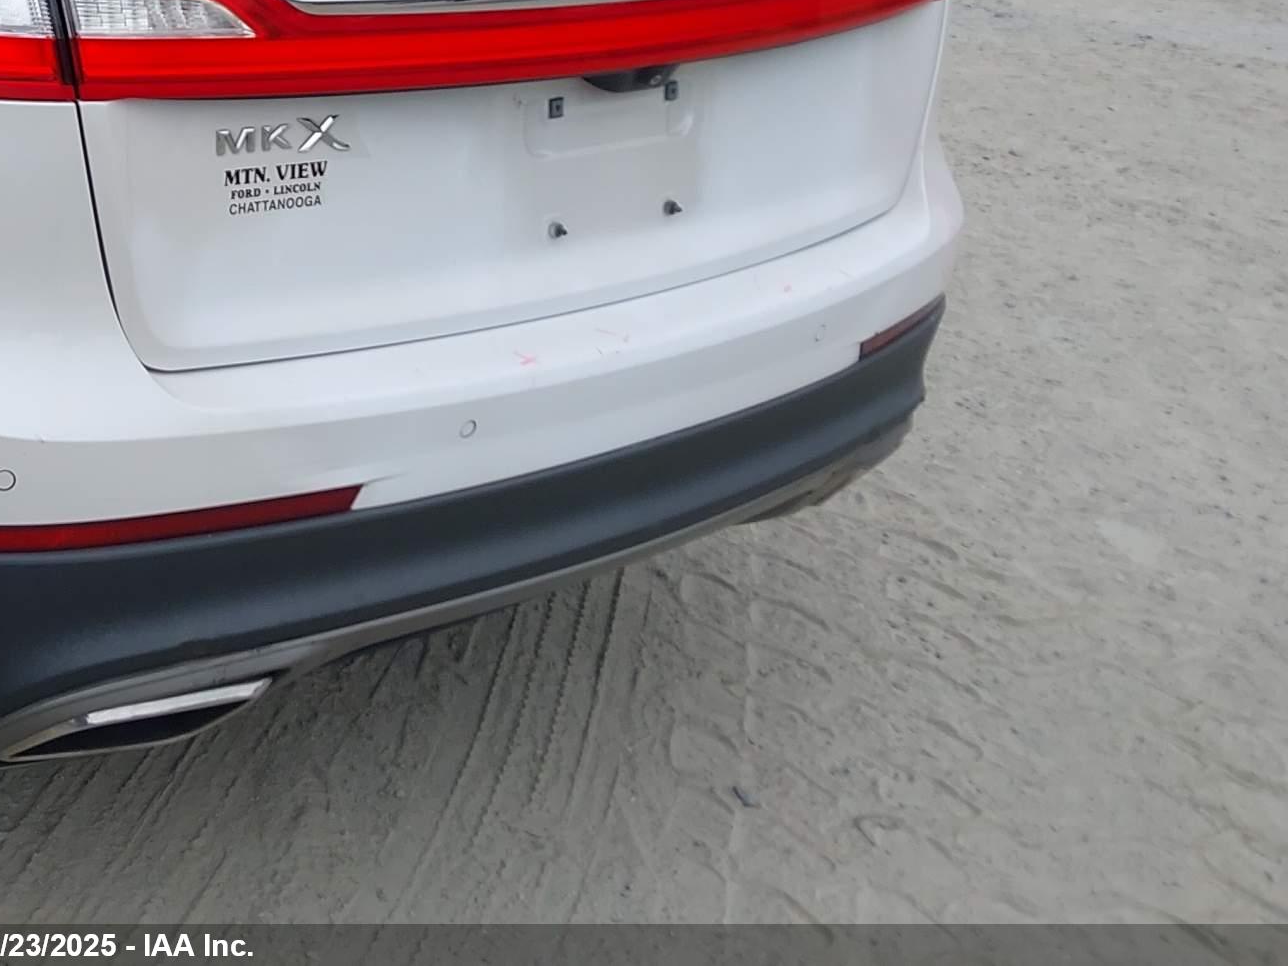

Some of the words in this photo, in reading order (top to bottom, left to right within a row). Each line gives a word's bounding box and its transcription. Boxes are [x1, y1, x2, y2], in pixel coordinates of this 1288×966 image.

[215, 113, 352, 157] MKX
[224, 167, 271, 186] MTN.
[275, 160, 329, 181] VIEW
[230, 188, 262, 200] FORD
[273, 181, 322, 195] LINCOLN
[228, 195, 323, 216] CHATTANOOGA
